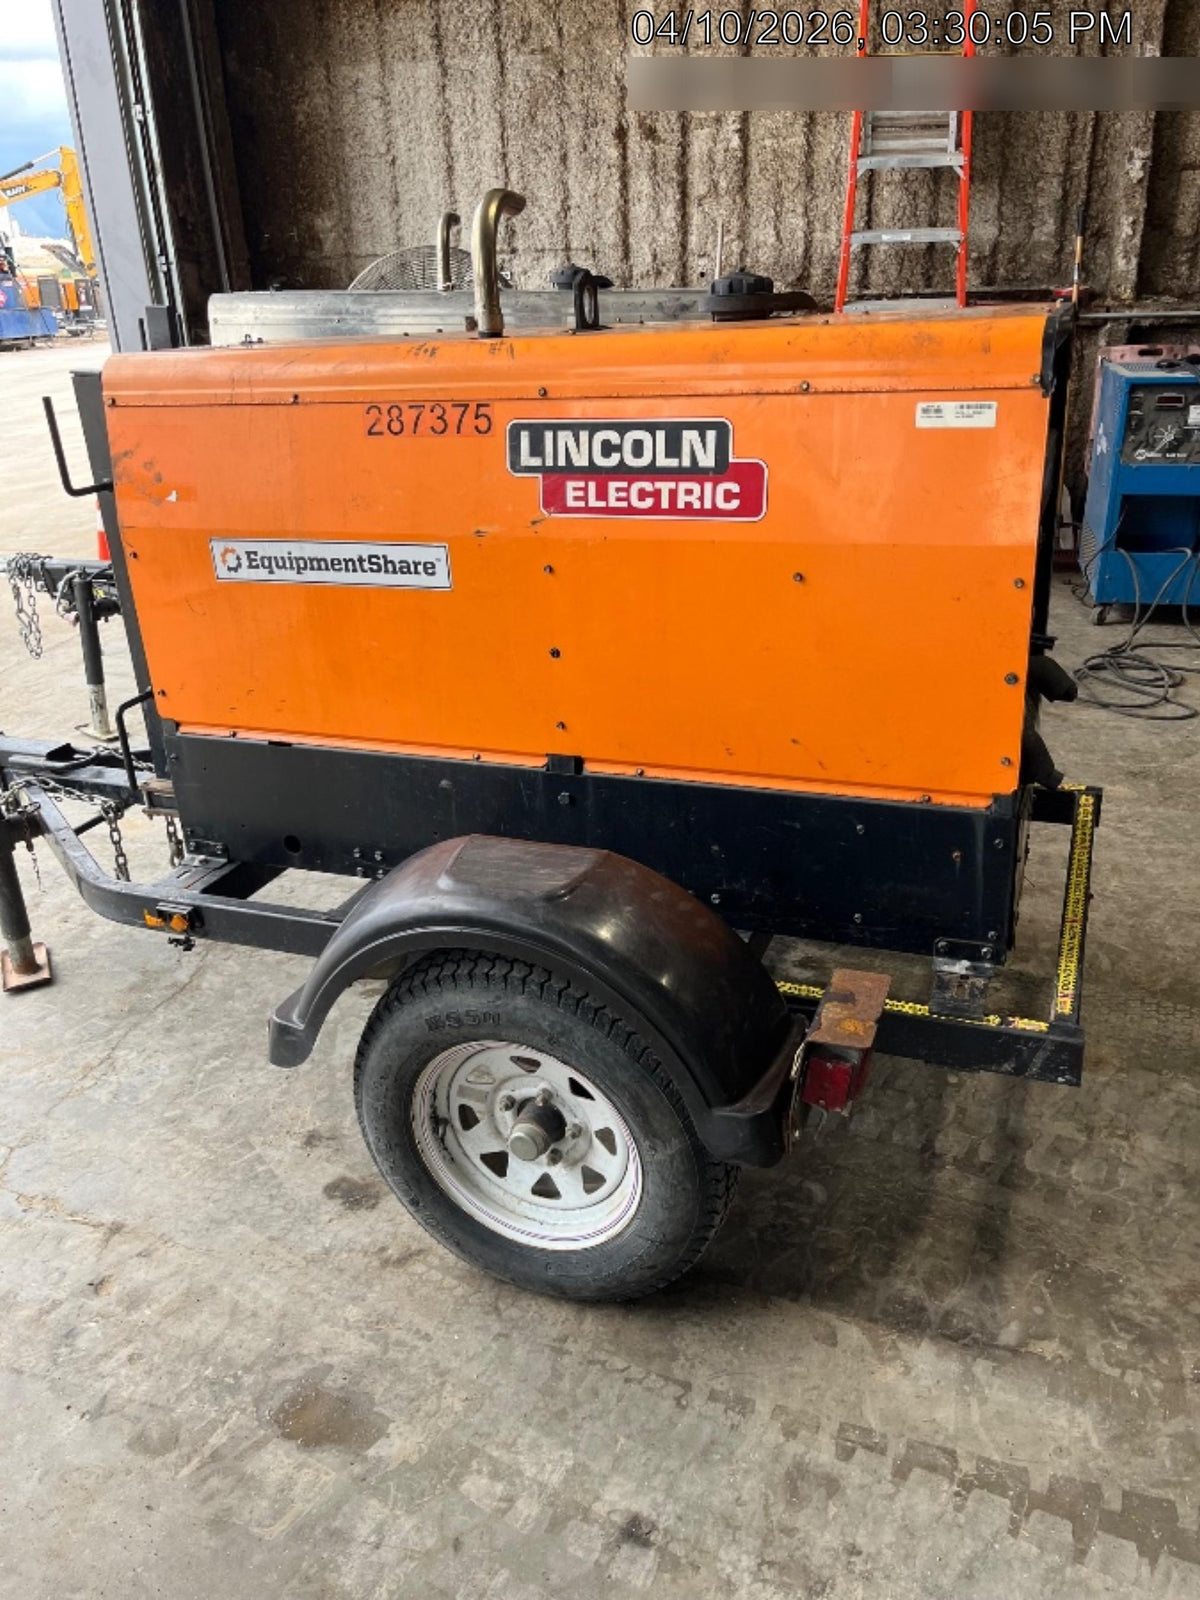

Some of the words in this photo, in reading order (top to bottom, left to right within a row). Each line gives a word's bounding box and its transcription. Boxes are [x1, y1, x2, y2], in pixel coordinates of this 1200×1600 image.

[366, 403, 492, 436] 287375
[519, 429, 717, 468] LINCOLN
[566, 480, 741, 510] ELECTRIC
[244, 551, 437, 577] EquipmentShare
